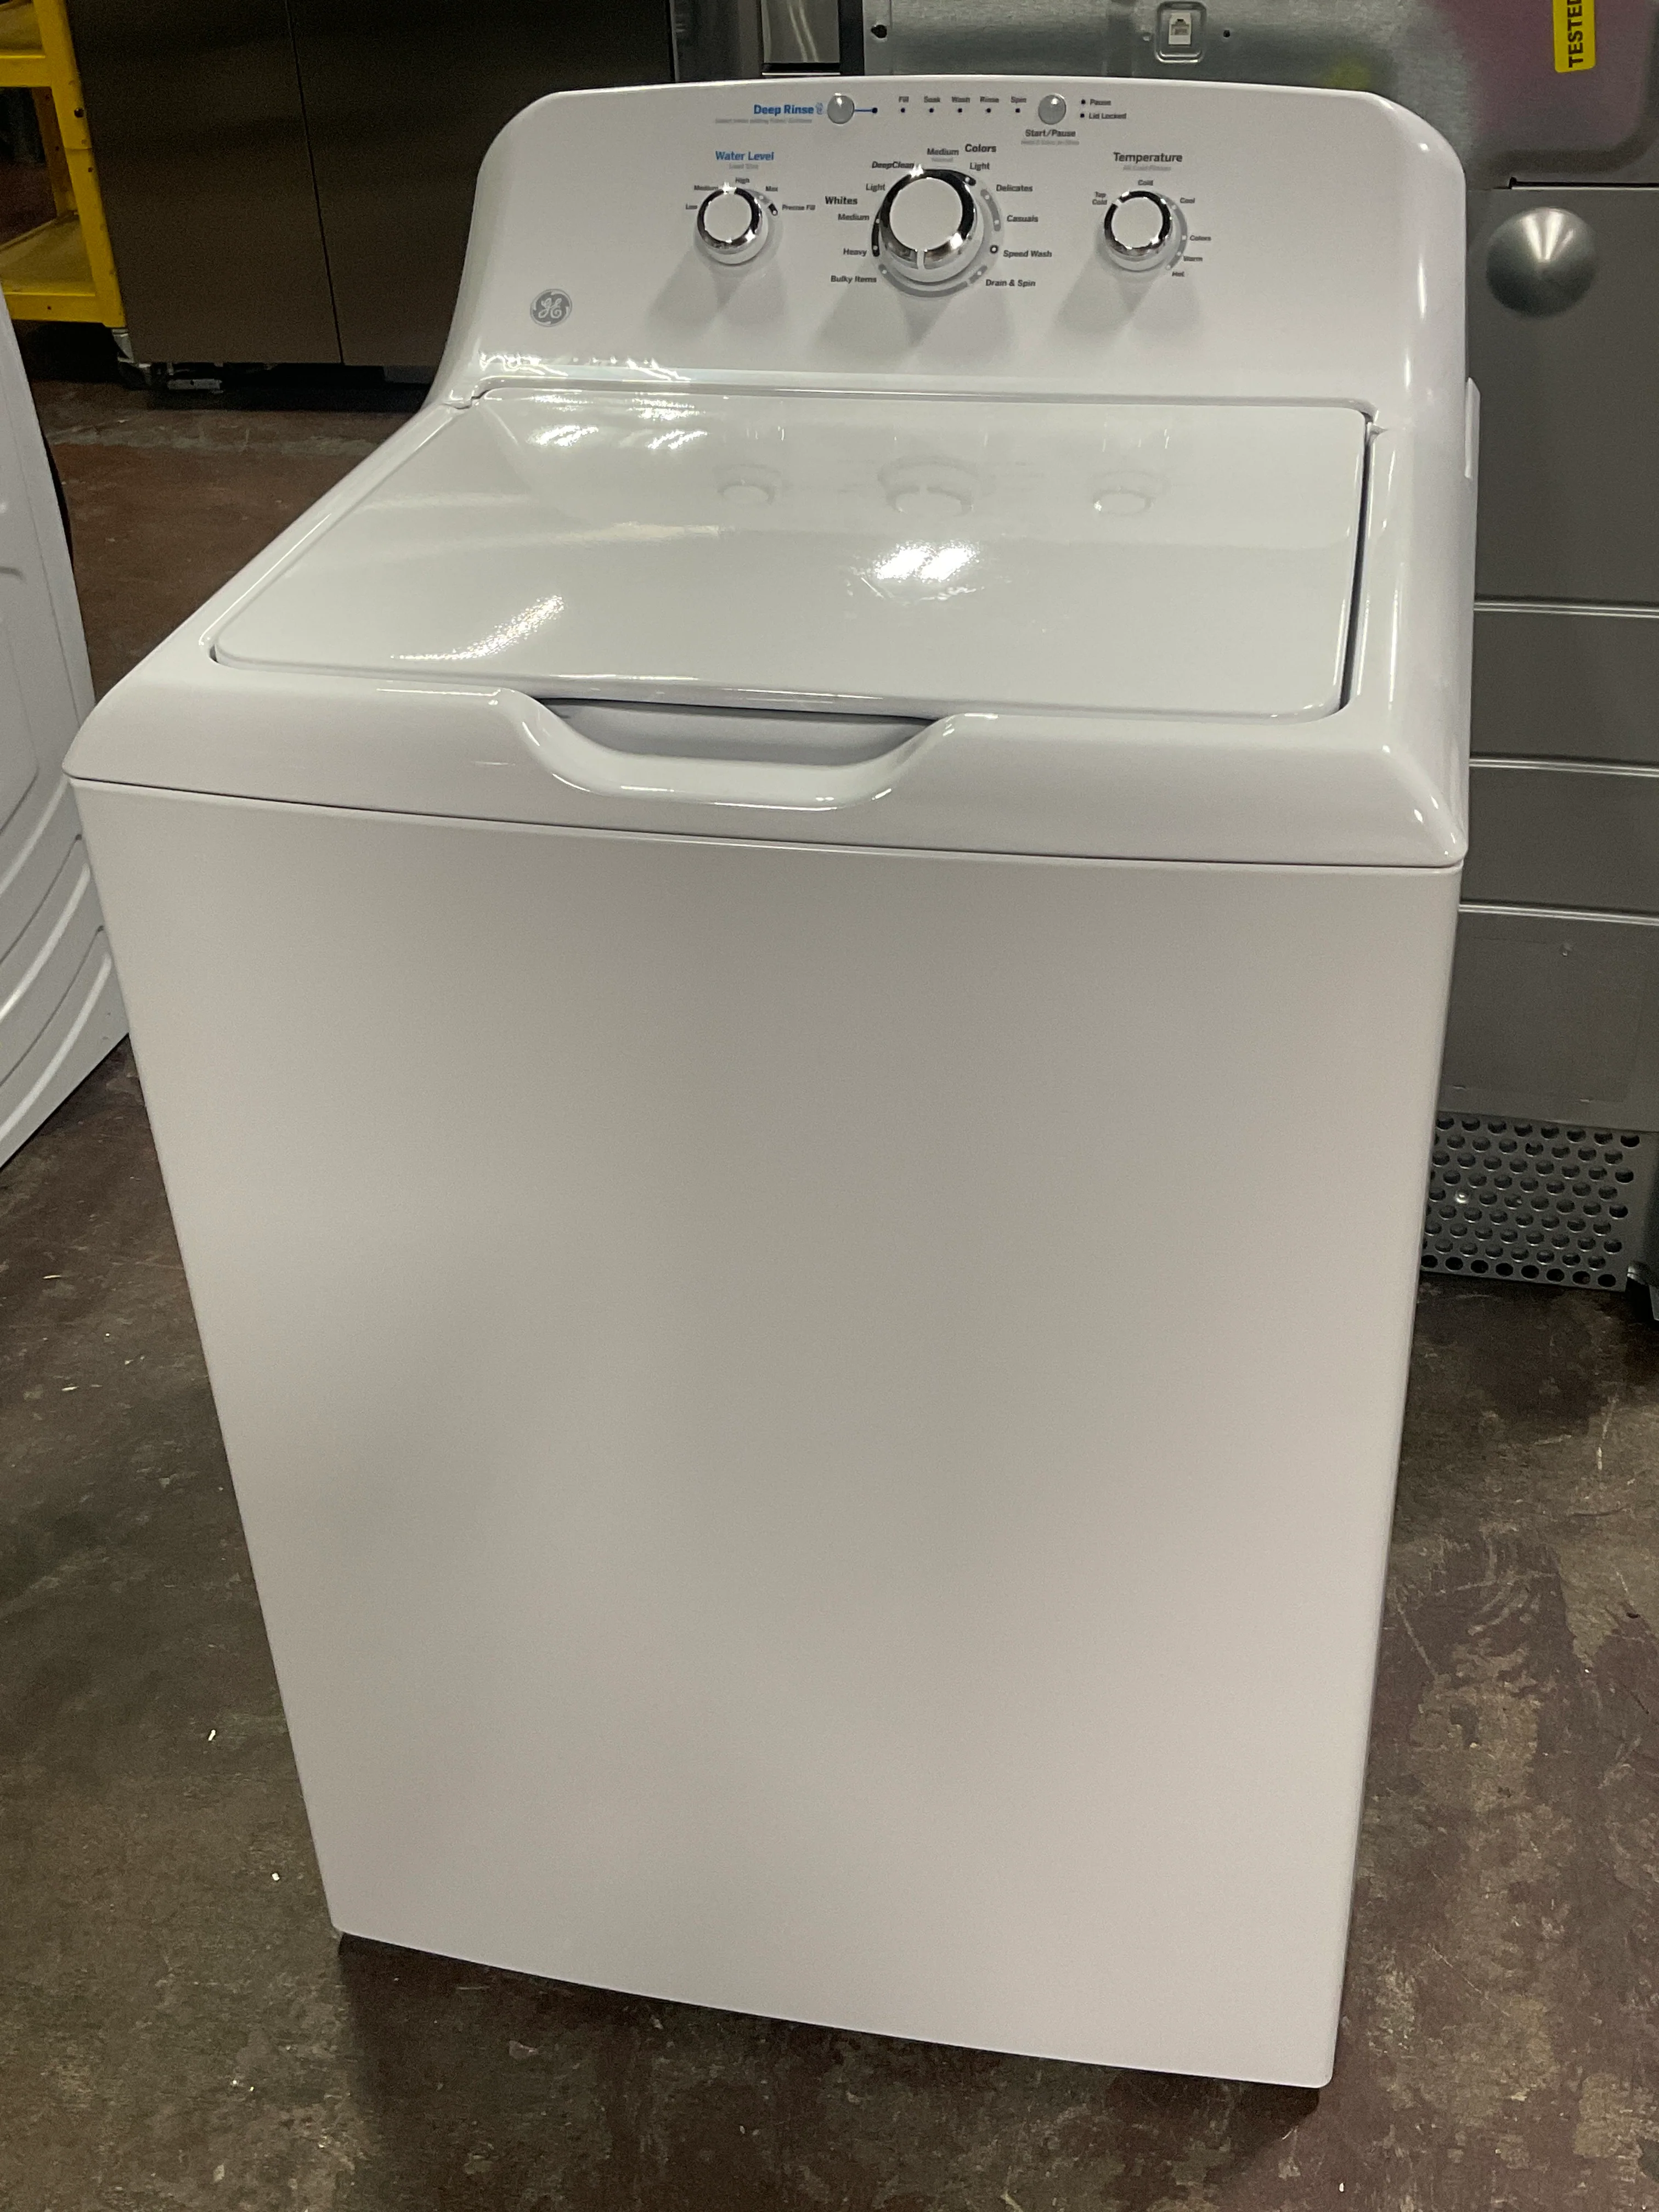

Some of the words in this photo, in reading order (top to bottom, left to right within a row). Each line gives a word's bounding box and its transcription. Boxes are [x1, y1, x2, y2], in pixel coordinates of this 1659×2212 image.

[754, 104, 781, 116] Deep
[784, 104, 814, 114] Rinse
[965, 143, 996, 153] Colors
[715, 151, 745, 161] Water
[748, 151, 774, 161] Level
[1113, 152, 1183, 163] Temperature
[872, 161, 914, 170] DeepClean
[969, 162, 990, 171] Light
[866, 183, 885, 192] Light
[825, 196, 857, 205] Whites
[843, 248, 867, 257] Heavy
[831, 275, 853, 284] Bulky
